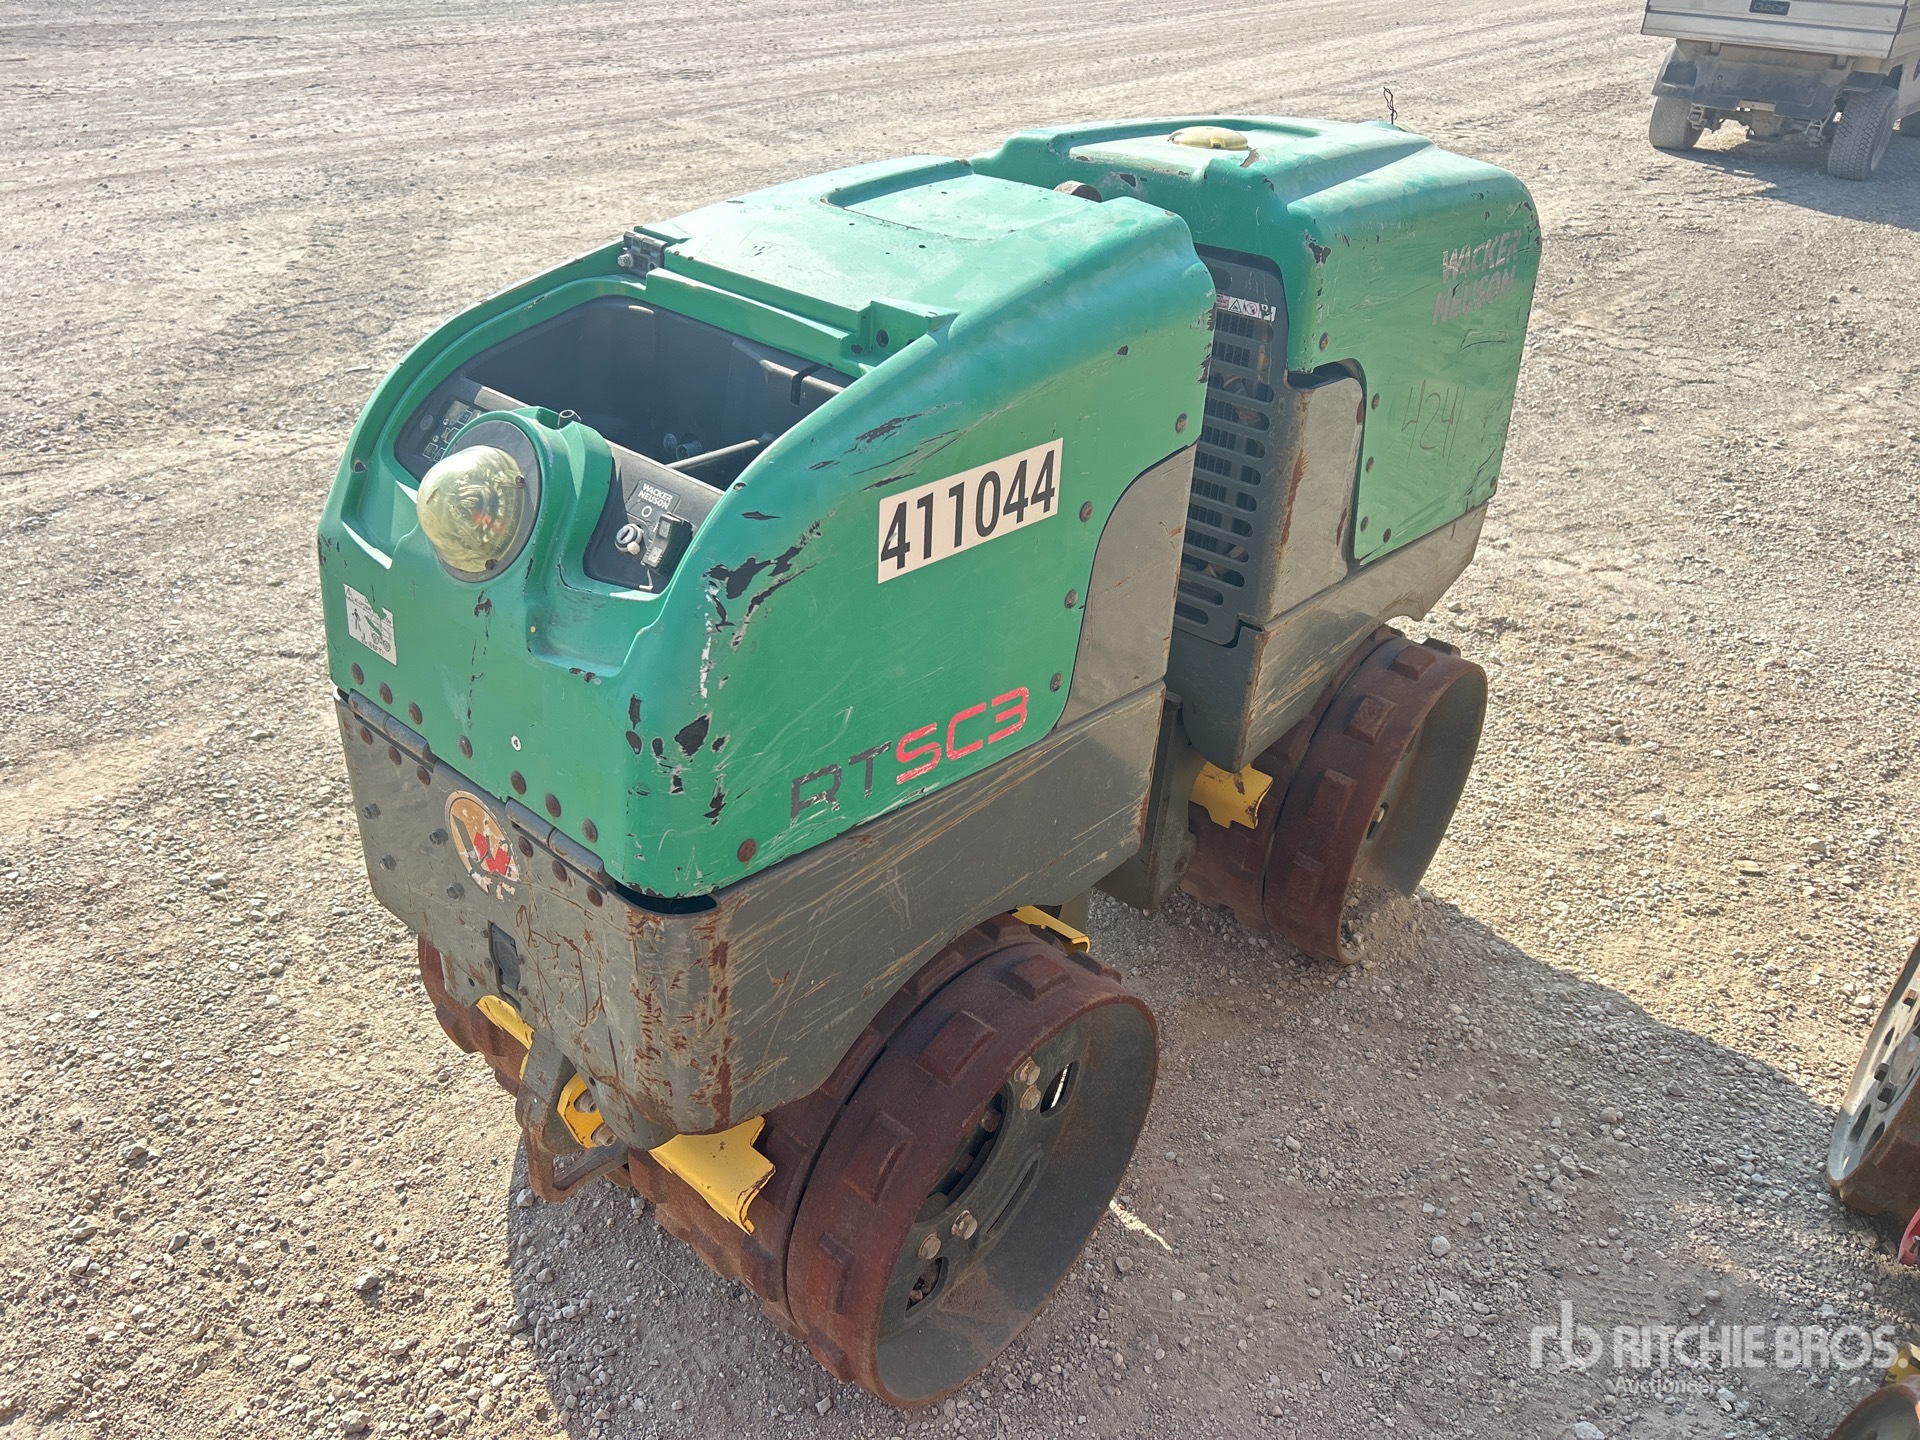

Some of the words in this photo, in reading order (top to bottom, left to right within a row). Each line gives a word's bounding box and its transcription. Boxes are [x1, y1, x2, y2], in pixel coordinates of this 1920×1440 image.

[1432, 265, 1517, 326] NEUSON
[638, 490, 671, 510] NEUSON
[642, 483, 673, 503] WACKER
[880, 450, 1055, 571] 411044
